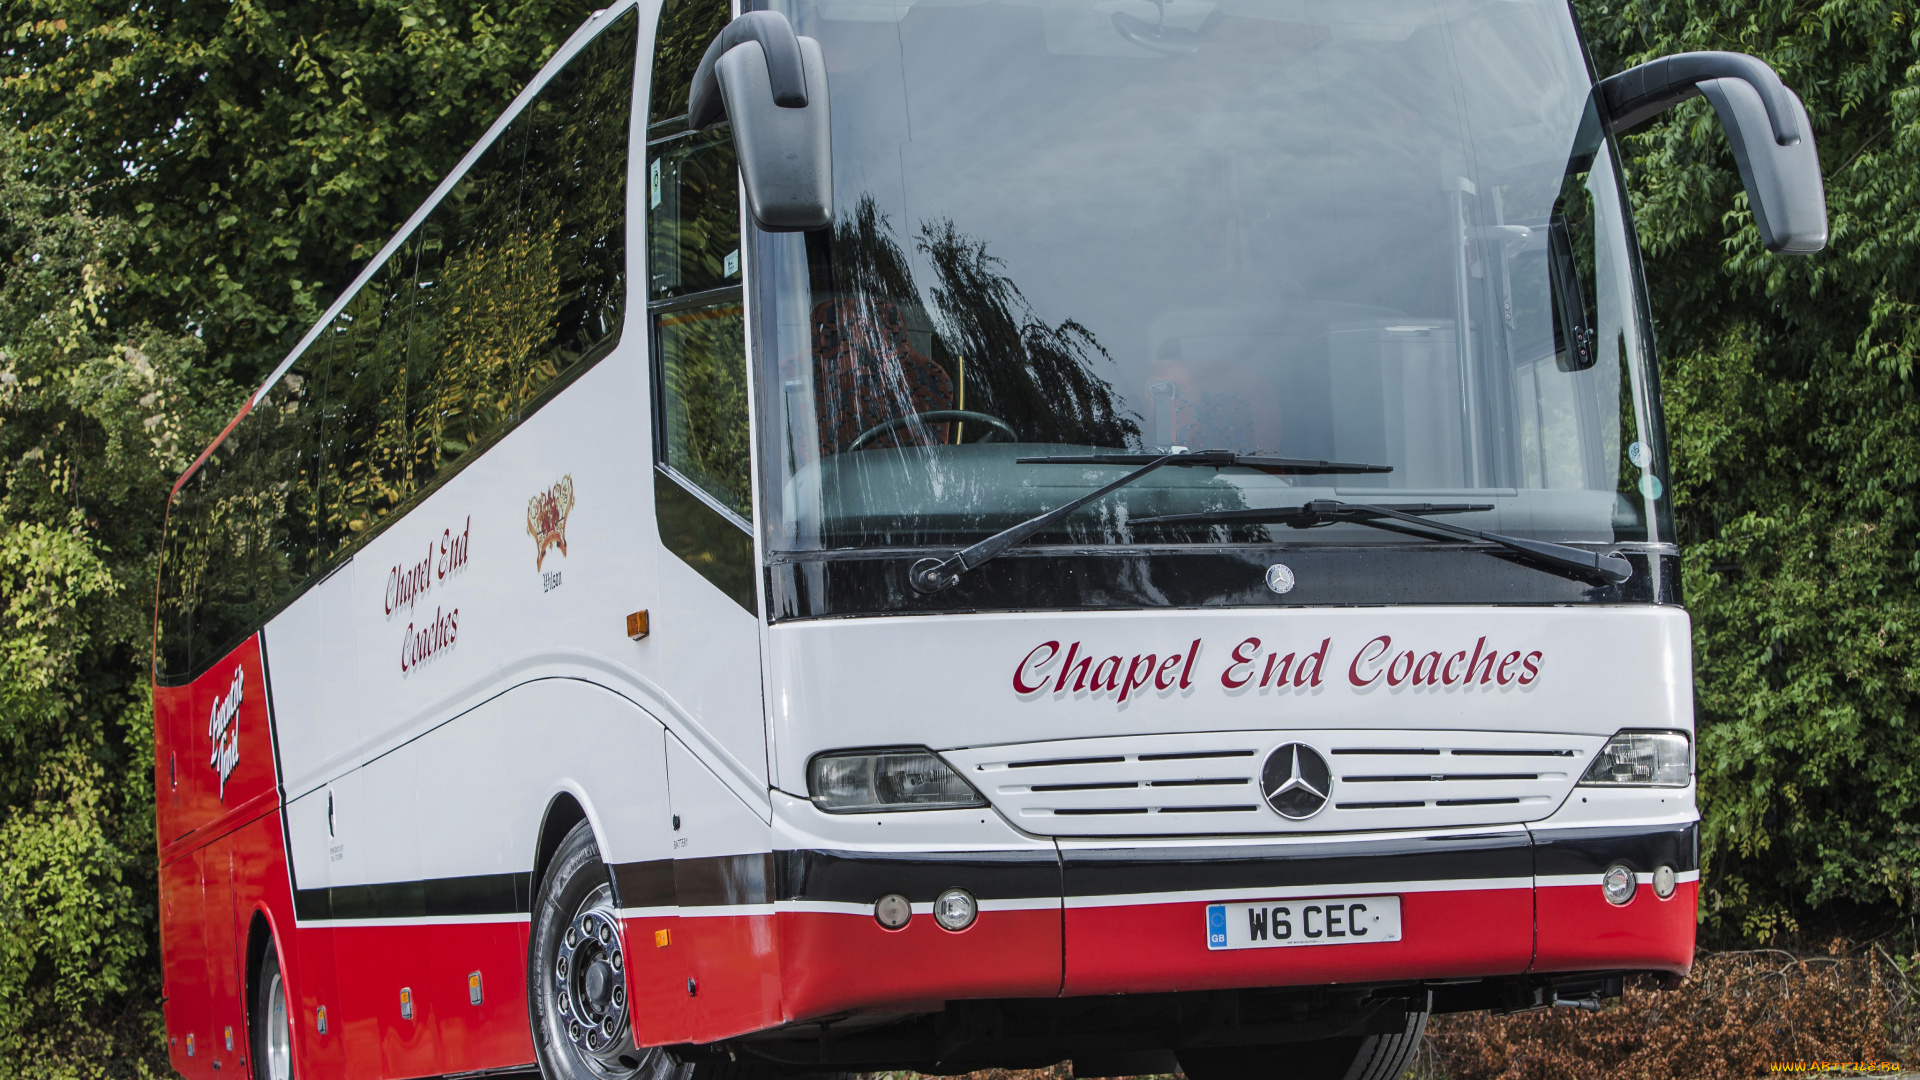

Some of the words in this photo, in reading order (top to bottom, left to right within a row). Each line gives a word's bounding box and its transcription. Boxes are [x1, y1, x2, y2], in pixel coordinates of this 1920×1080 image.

[385, 541, 434, 617] Chapel
[438, 514, 471, 580] End
[401, 605, 459, 673] Coaches
[1012, 637, 1202, 705] Chapel
[1220, 637, 1332, 689] End
[1347, 635, 1543, 688] Coaches
[1211, 934, 1226, 943] GB
[1248, 906, 1292, 941] W6
[1303, 903, 1369, 939] CEC
